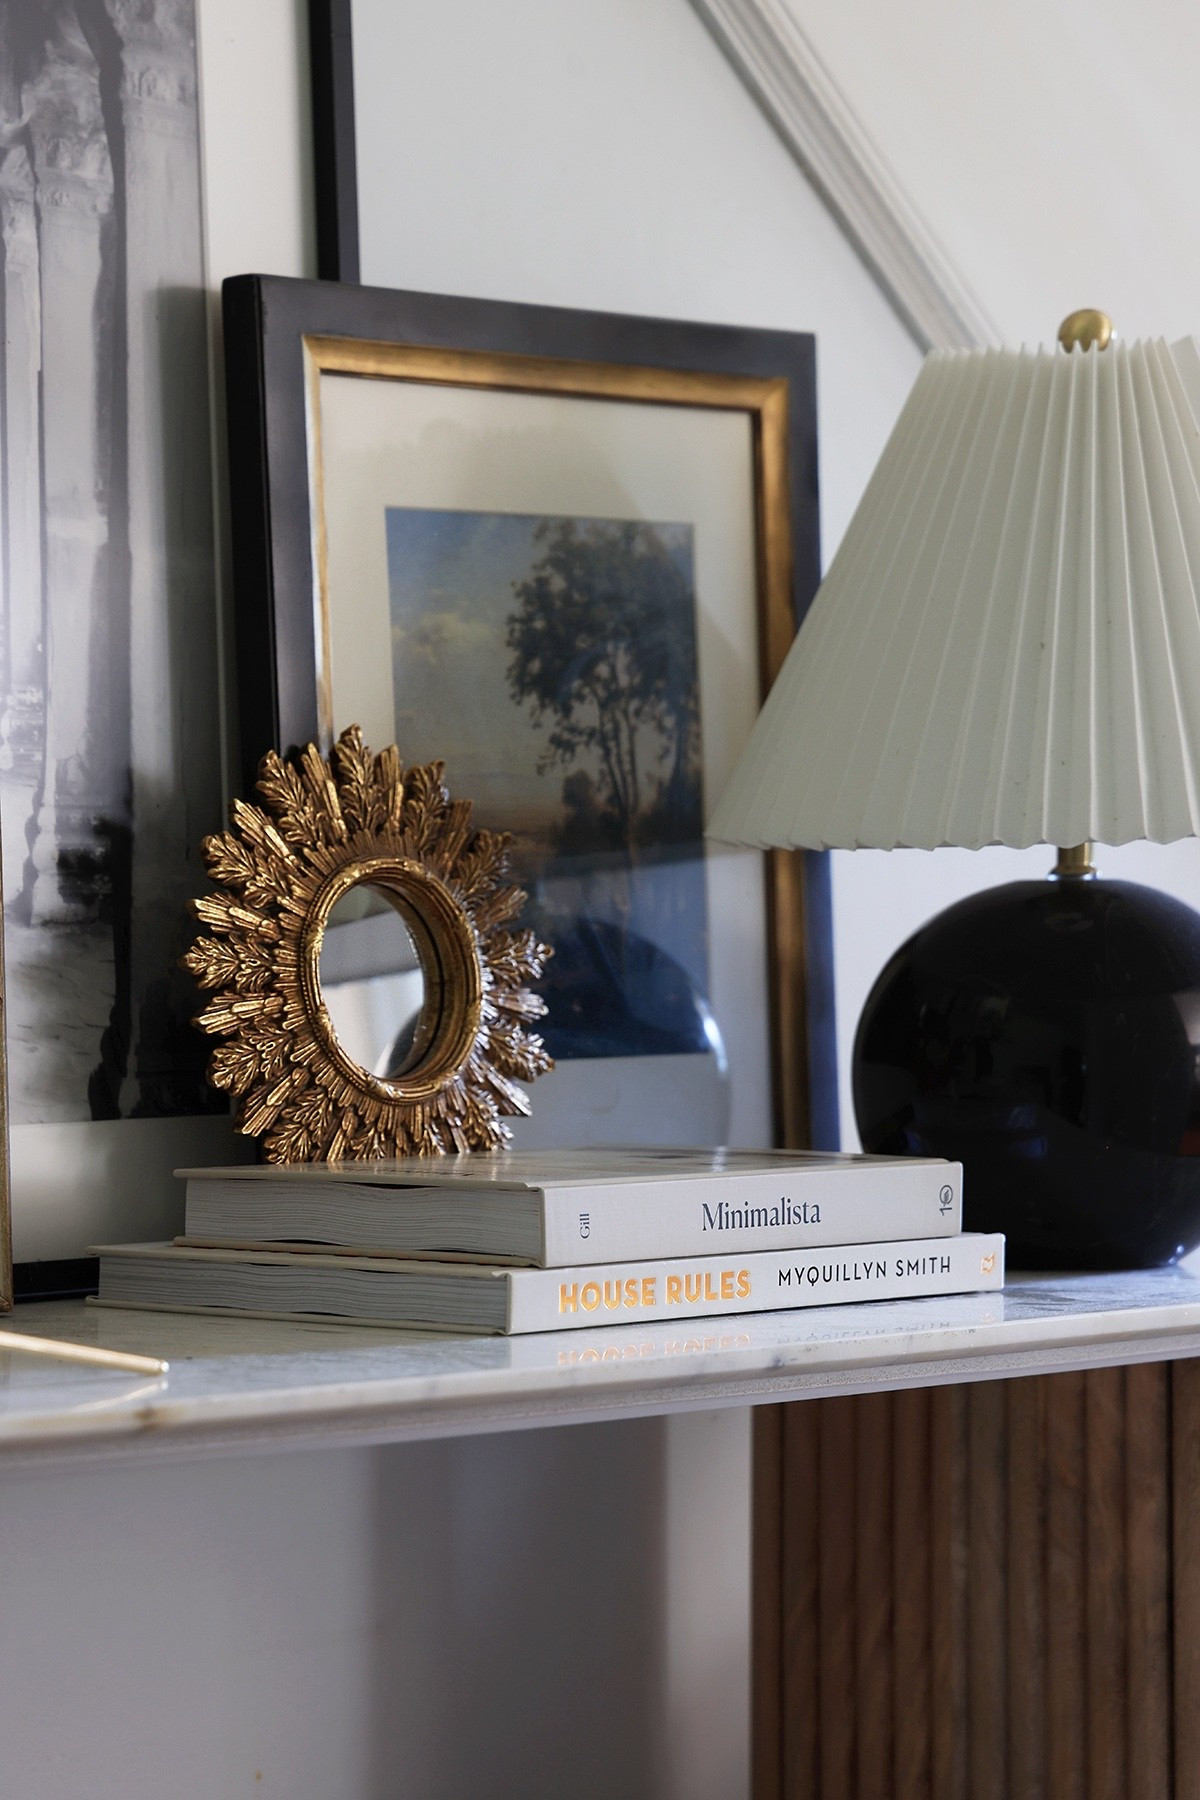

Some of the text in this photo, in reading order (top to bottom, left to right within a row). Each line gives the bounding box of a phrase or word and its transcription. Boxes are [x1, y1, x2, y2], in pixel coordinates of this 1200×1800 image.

[579, 1213, 590, 1239] Gill
[702, 1197, 821, 1231] Minimalista
[778, 1256, 951, 1287] MYQUILLYN SMITH
[558, 1269, 751, 1314] HOUSE RULES
